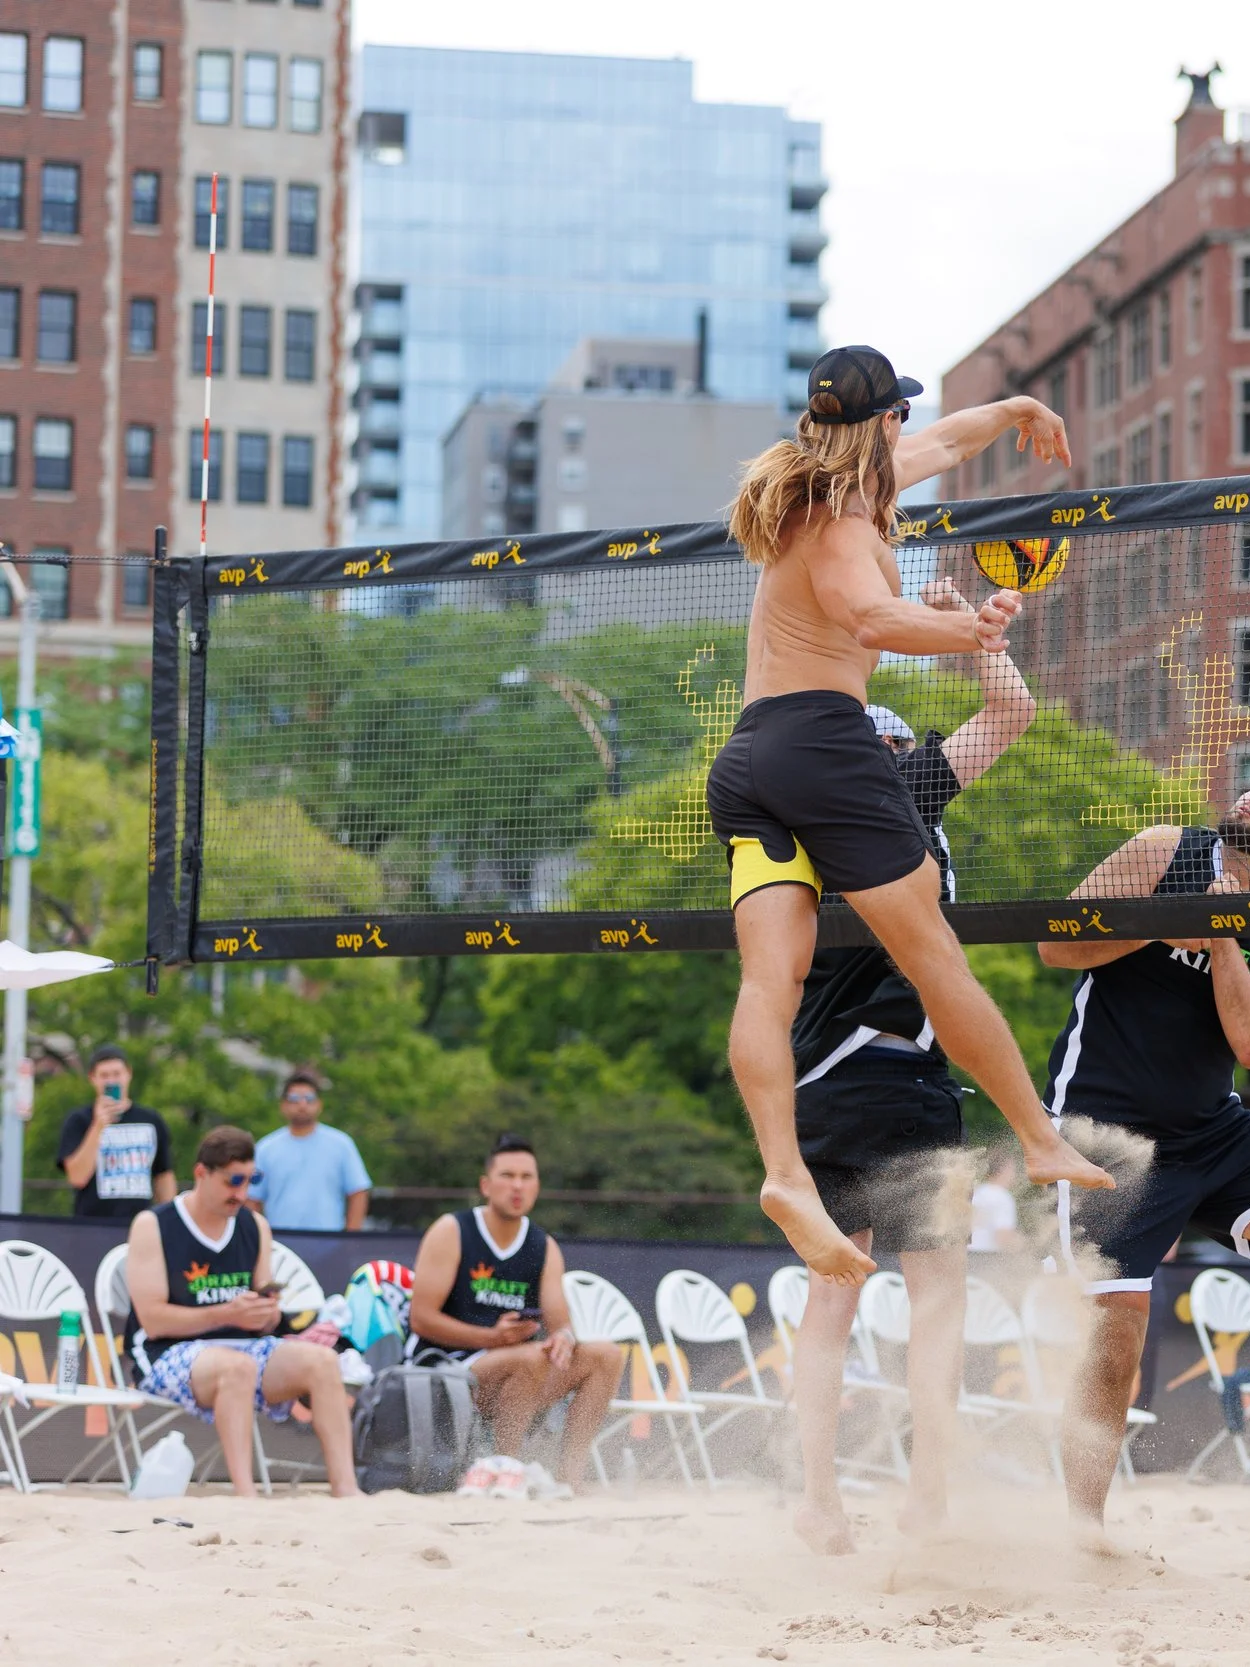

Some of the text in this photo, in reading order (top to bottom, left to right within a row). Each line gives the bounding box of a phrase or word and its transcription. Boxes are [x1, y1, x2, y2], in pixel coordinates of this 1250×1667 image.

[819, 379, 833, 388] avp
[1214, 493, 1249, 512] avp
[1051, 507, 1086, 528] avp
[896, 519, 928, 539] avp
[607, 542, 637, 559] avp
[344, 561, 371, 578] avp
[472, 552, 500, 569] avp
[218, 568, 246, 587] avp
[1048, 919, 1081, 937] avp
[1210, 914, 1247, 932] avp
[214, 937, 240, 957] avp
[335, 933, 364, 953] avp
[465, 931, 494, 949] avp
[600, 929, 630, 948] avp
[188, 1271, 252, 1294] DRAFT
